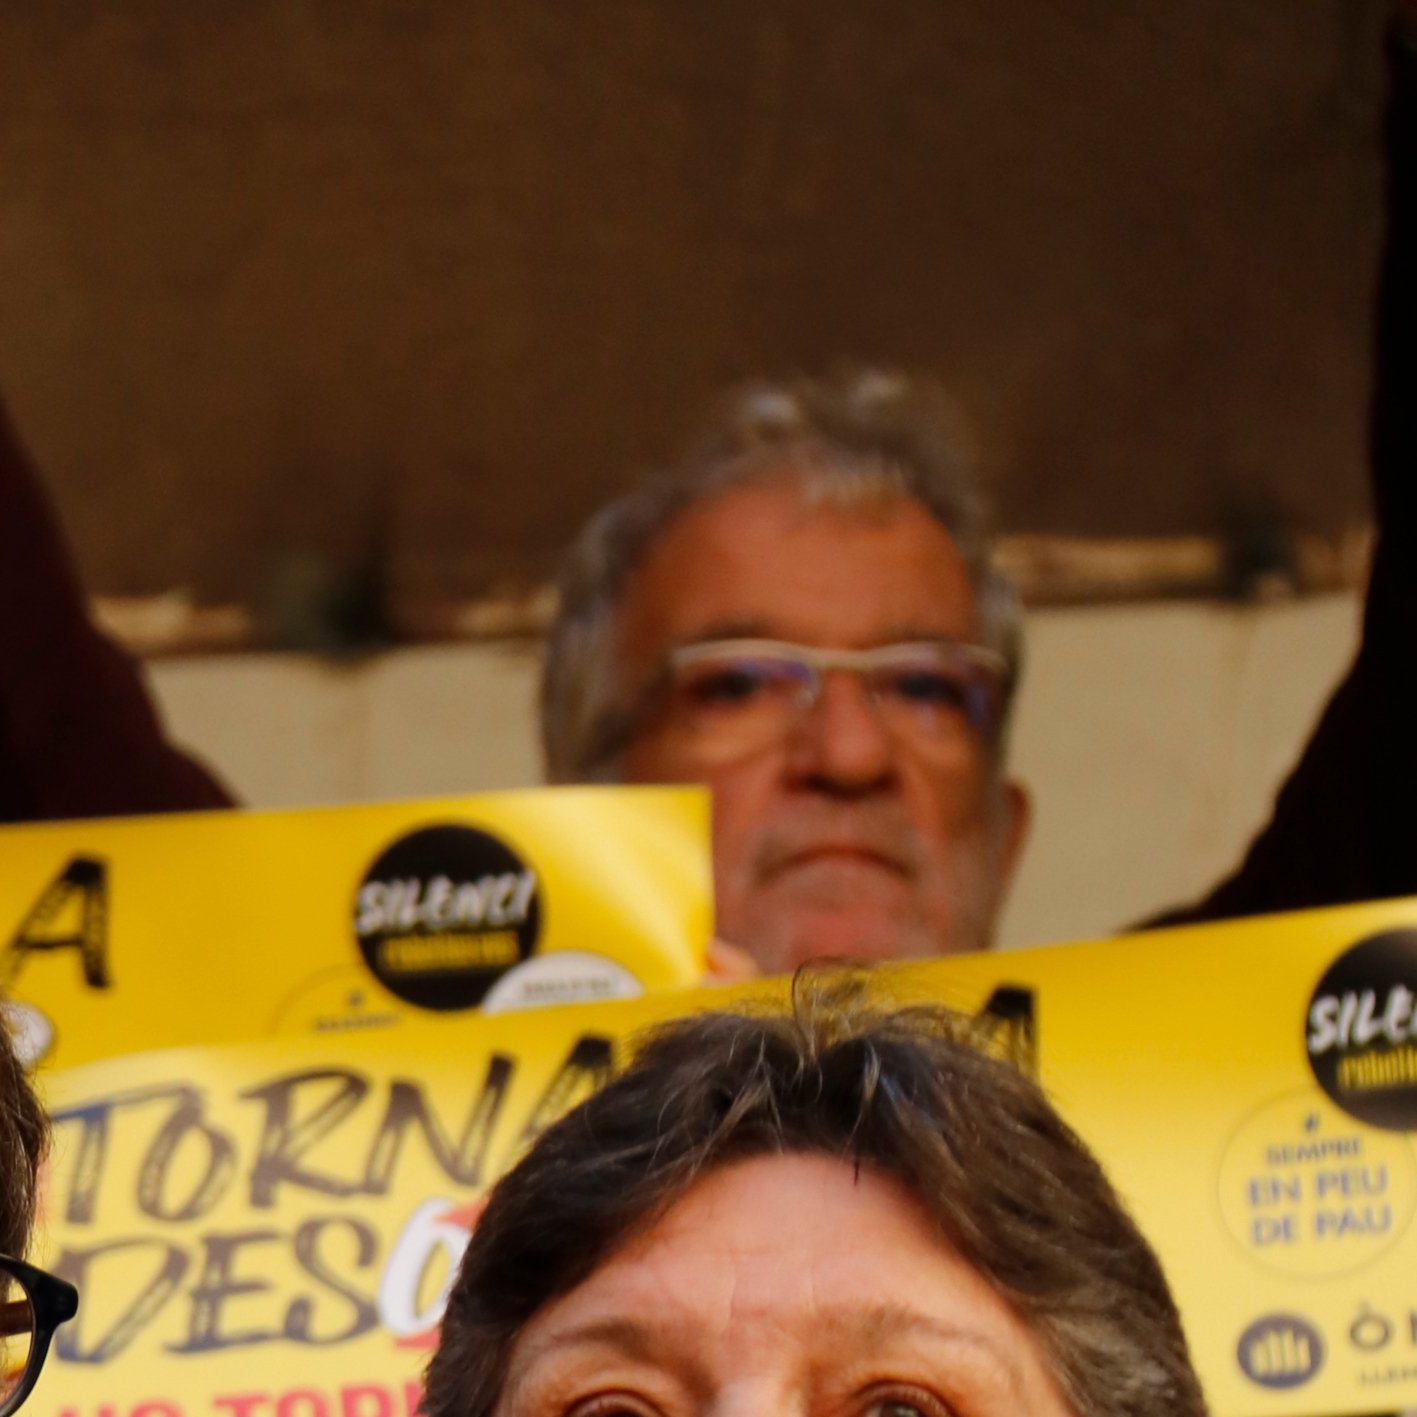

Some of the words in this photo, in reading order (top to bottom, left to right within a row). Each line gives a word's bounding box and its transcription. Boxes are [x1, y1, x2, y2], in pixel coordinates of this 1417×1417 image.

[1248, 1176, 1301, 1206] EN
[1315, 1165, 1388, 1200] PEU
[1251, 1216, 1293, 1245] DE
[1315, 1204, 1393, 1239] PAU
